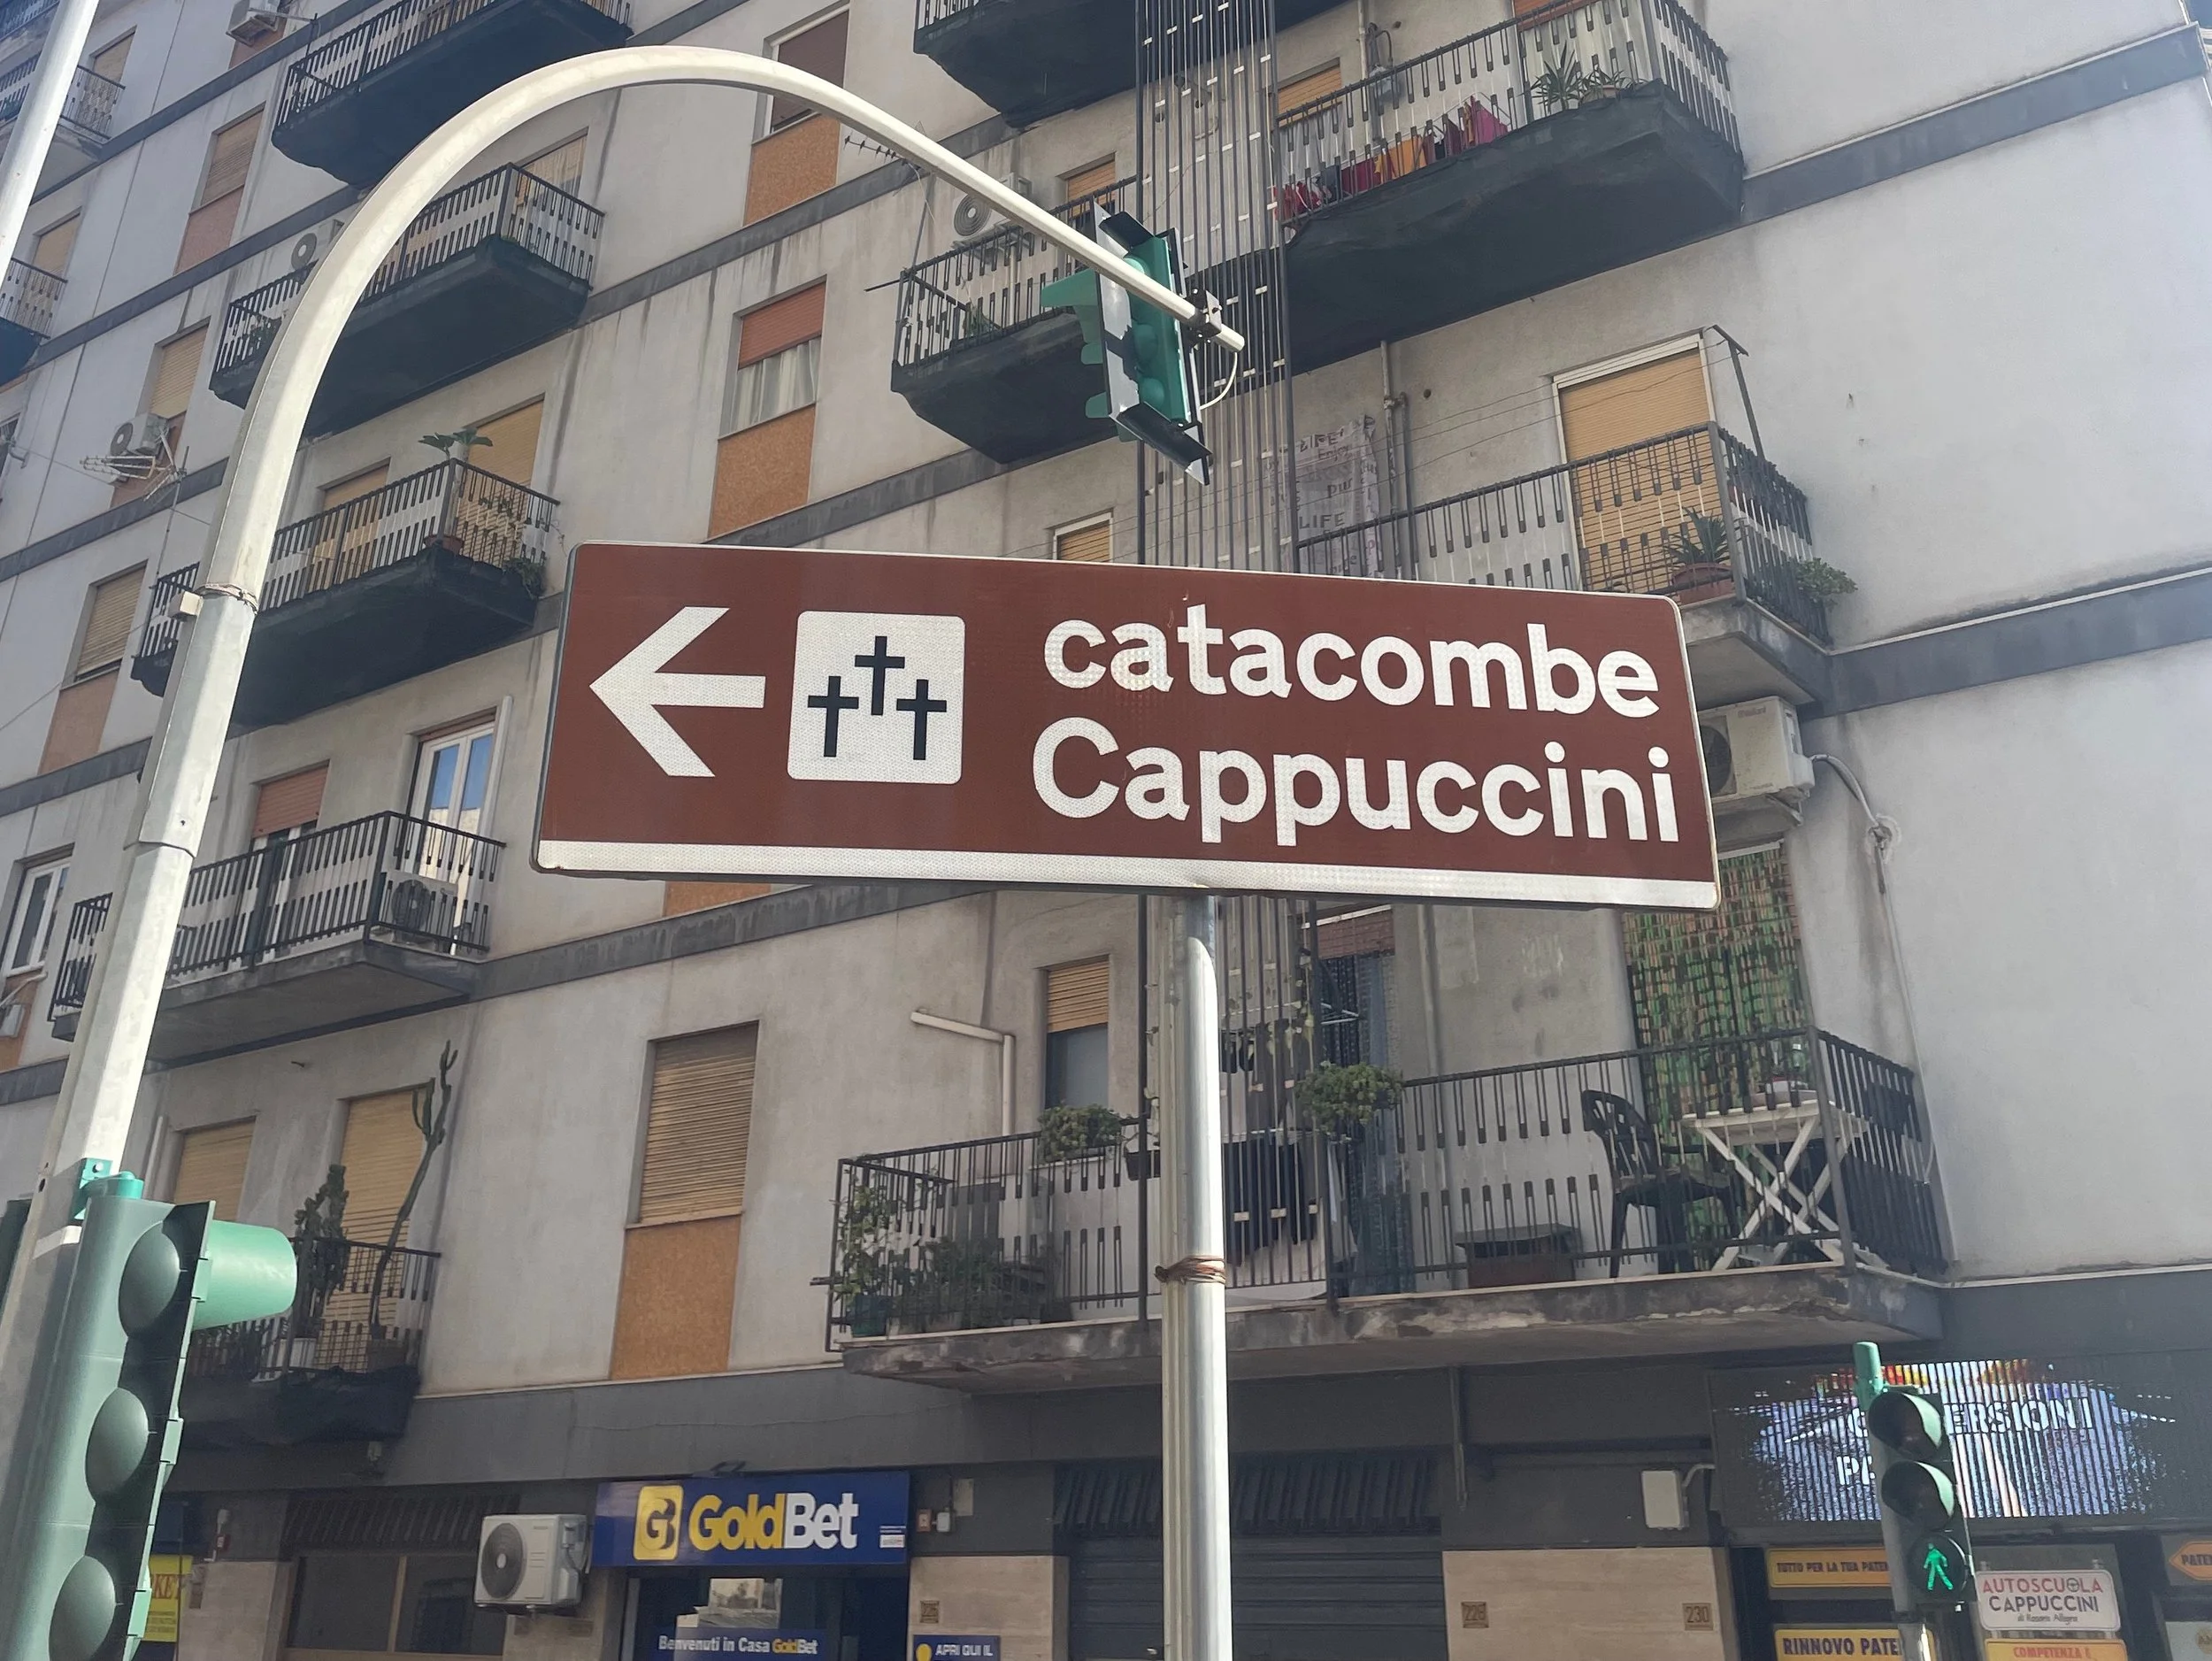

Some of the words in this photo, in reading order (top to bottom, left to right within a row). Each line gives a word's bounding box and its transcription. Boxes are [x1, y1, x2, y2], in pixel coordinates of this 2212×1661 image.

[1299, 511, 1345, 529] LIFE
[1043, 604, 1660, 719] catacombe
[1033, 717, 1679, 847] Cappuccini
[688, 1492, 859, 1550] GoldBet
[1777, 1562, 1803, 1573] TUTTO
[1806, 1562, 1824, 1573] PER
[1826, 1562, 1838, 1573] LA
[1840, 1561, 1859, 1572] TUA
[1983, 1577, 2103, 1594] AUTOSCUOLA
[1989, 1596, 2099, 1612] CAPPUCCINI
[1686, 1605, 1709, 1623] 230
[658, 1634, 719, 1652] Benvenuti
[723, 1636, 735, 1652] in
[738, 1637, 771, 1653] Casa
[962, 1644, 981, 1656] QUI
[1783, 1637, 1855, 1655] RINNOVO
[2013, 1647, 2082, 1659] COMPETENZA
